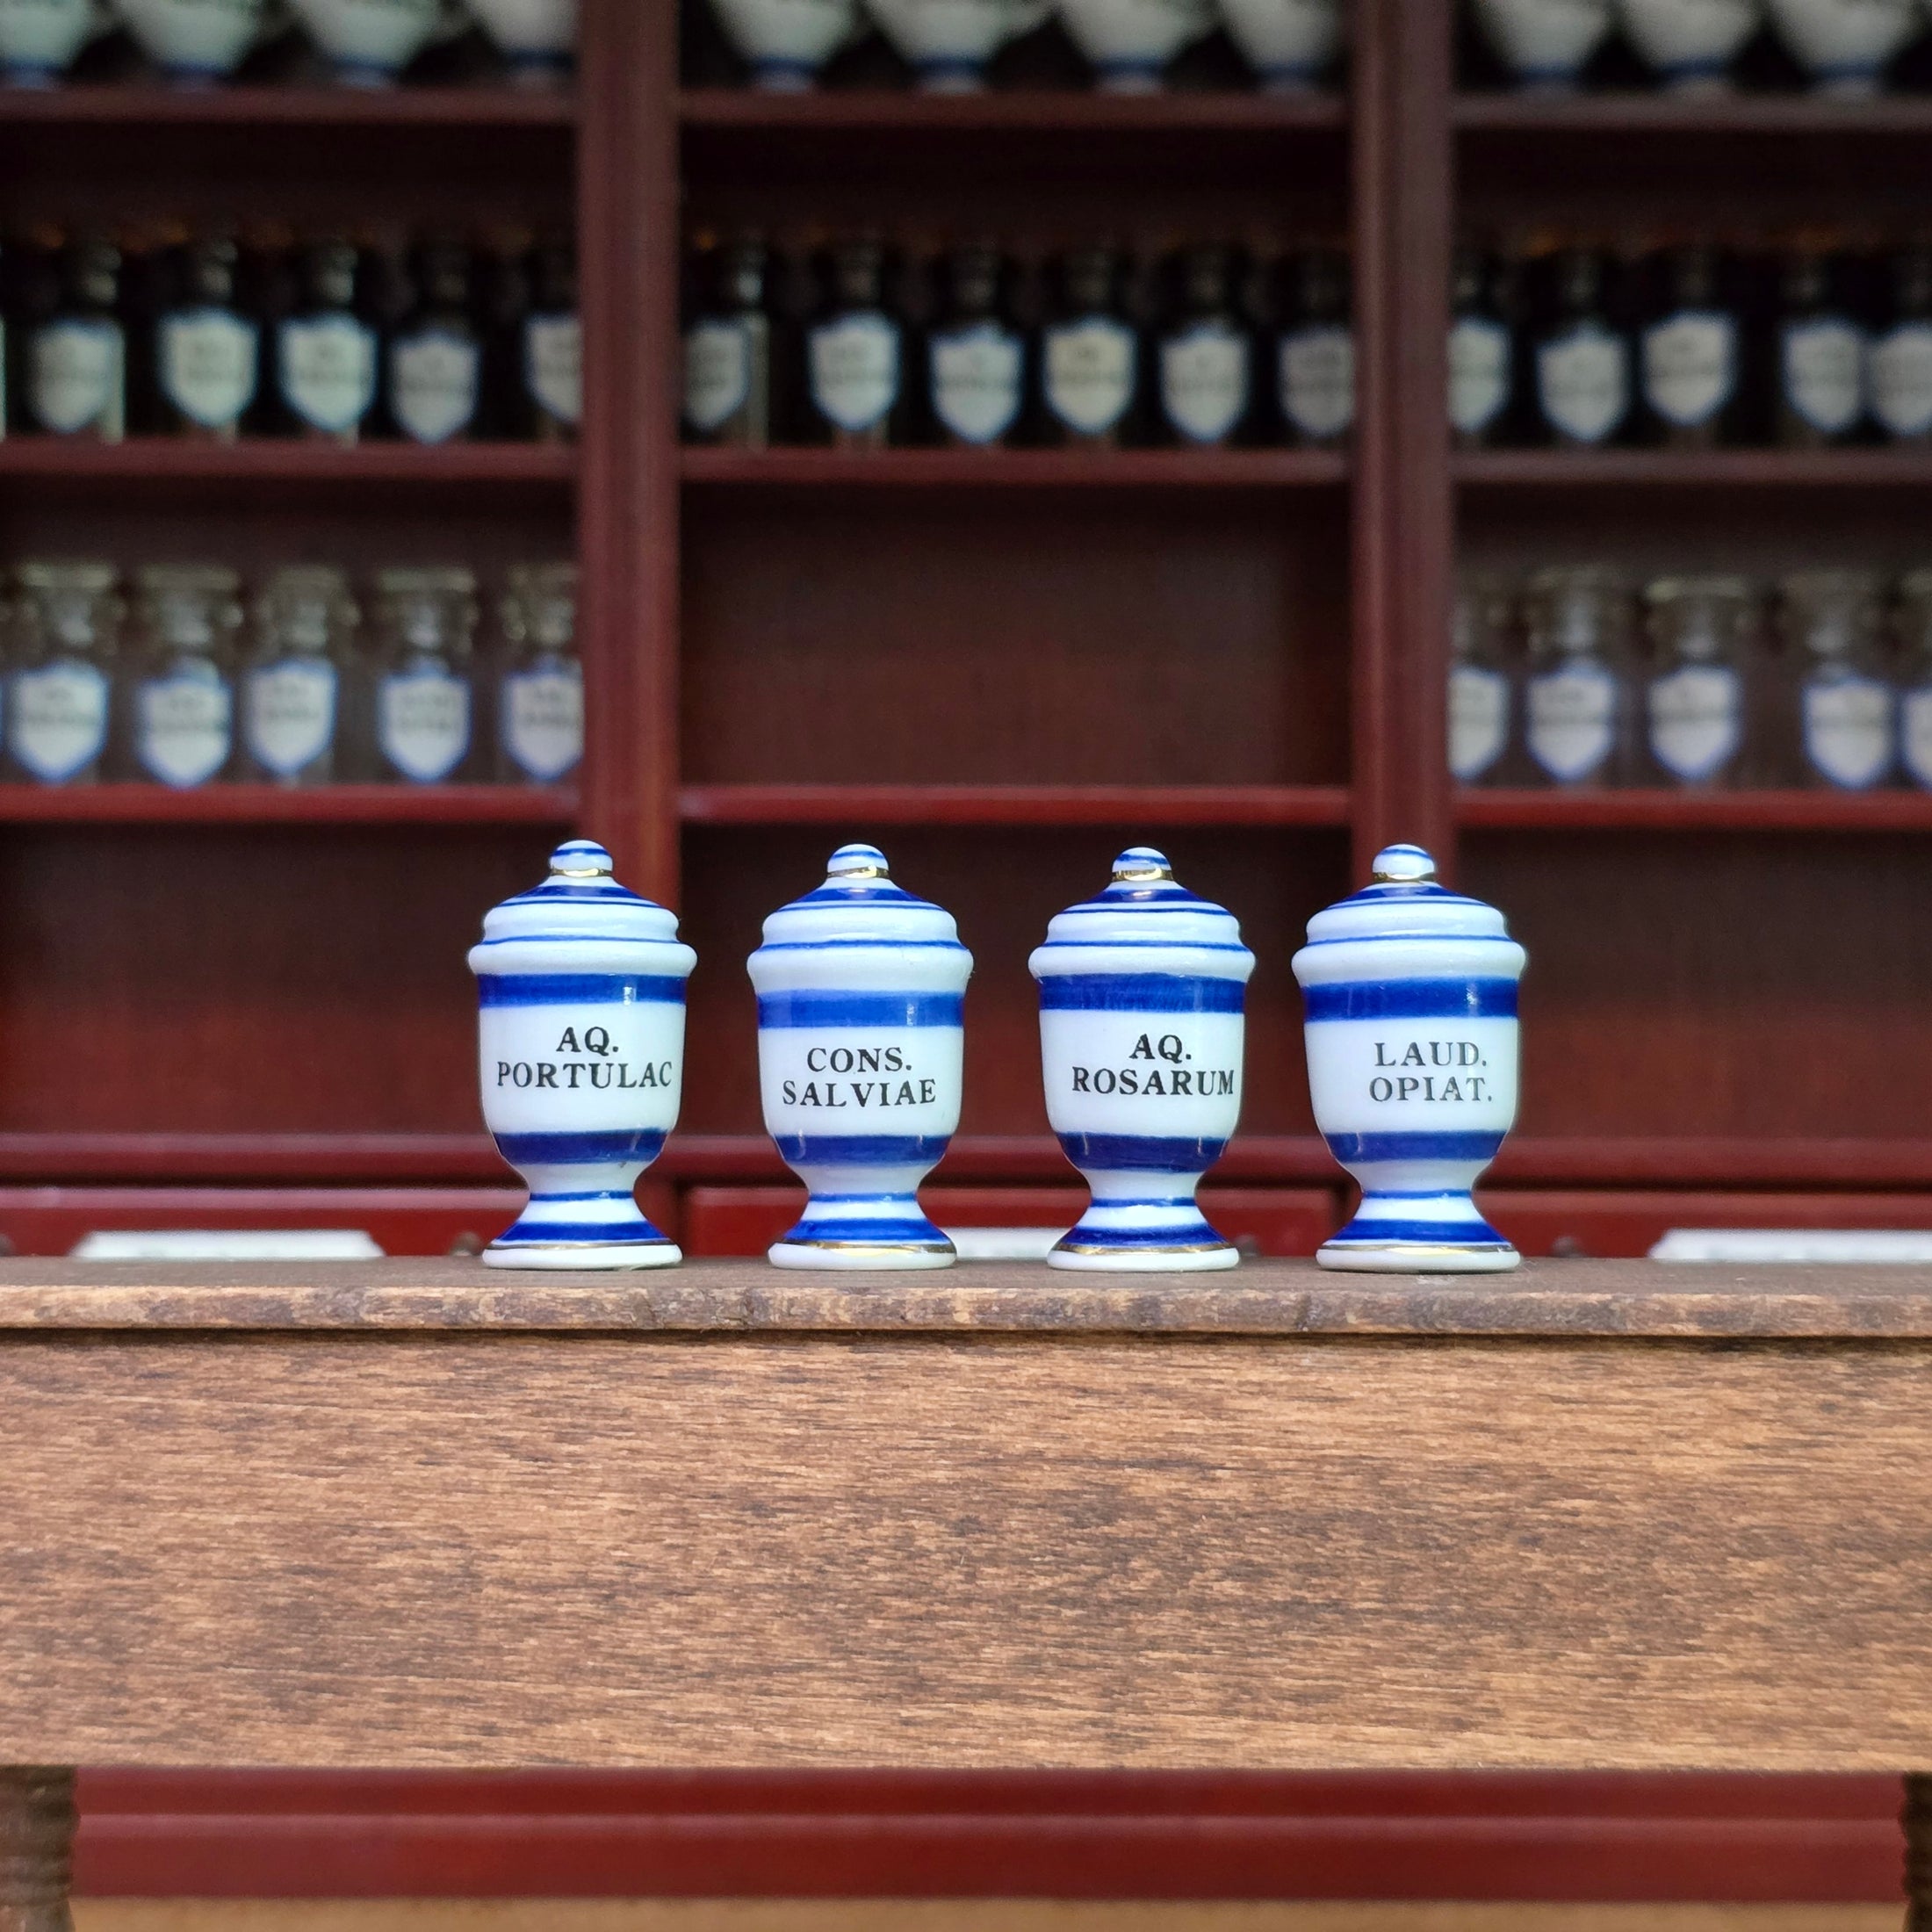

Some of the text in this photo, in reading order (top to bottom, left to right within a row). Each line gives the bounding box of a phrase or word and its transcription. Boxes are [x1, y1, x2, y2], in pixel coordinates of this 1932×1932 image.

[555, 1026, 619, 1057] AQ.
[1128, 1033, 1192, 1064] AQ.
[1374, 1042, 1487, 1067] LAUD.
[806, 1047, 912, 1073] CONS.
[497, 1061, 673, 1089] PORTULAC
[1071, 1066, 1235, 1096] ROSARUM
[1369, 1076, 1492, 1102] OPIAT.
[782, 1078, 936, 1108] SALVIAE
